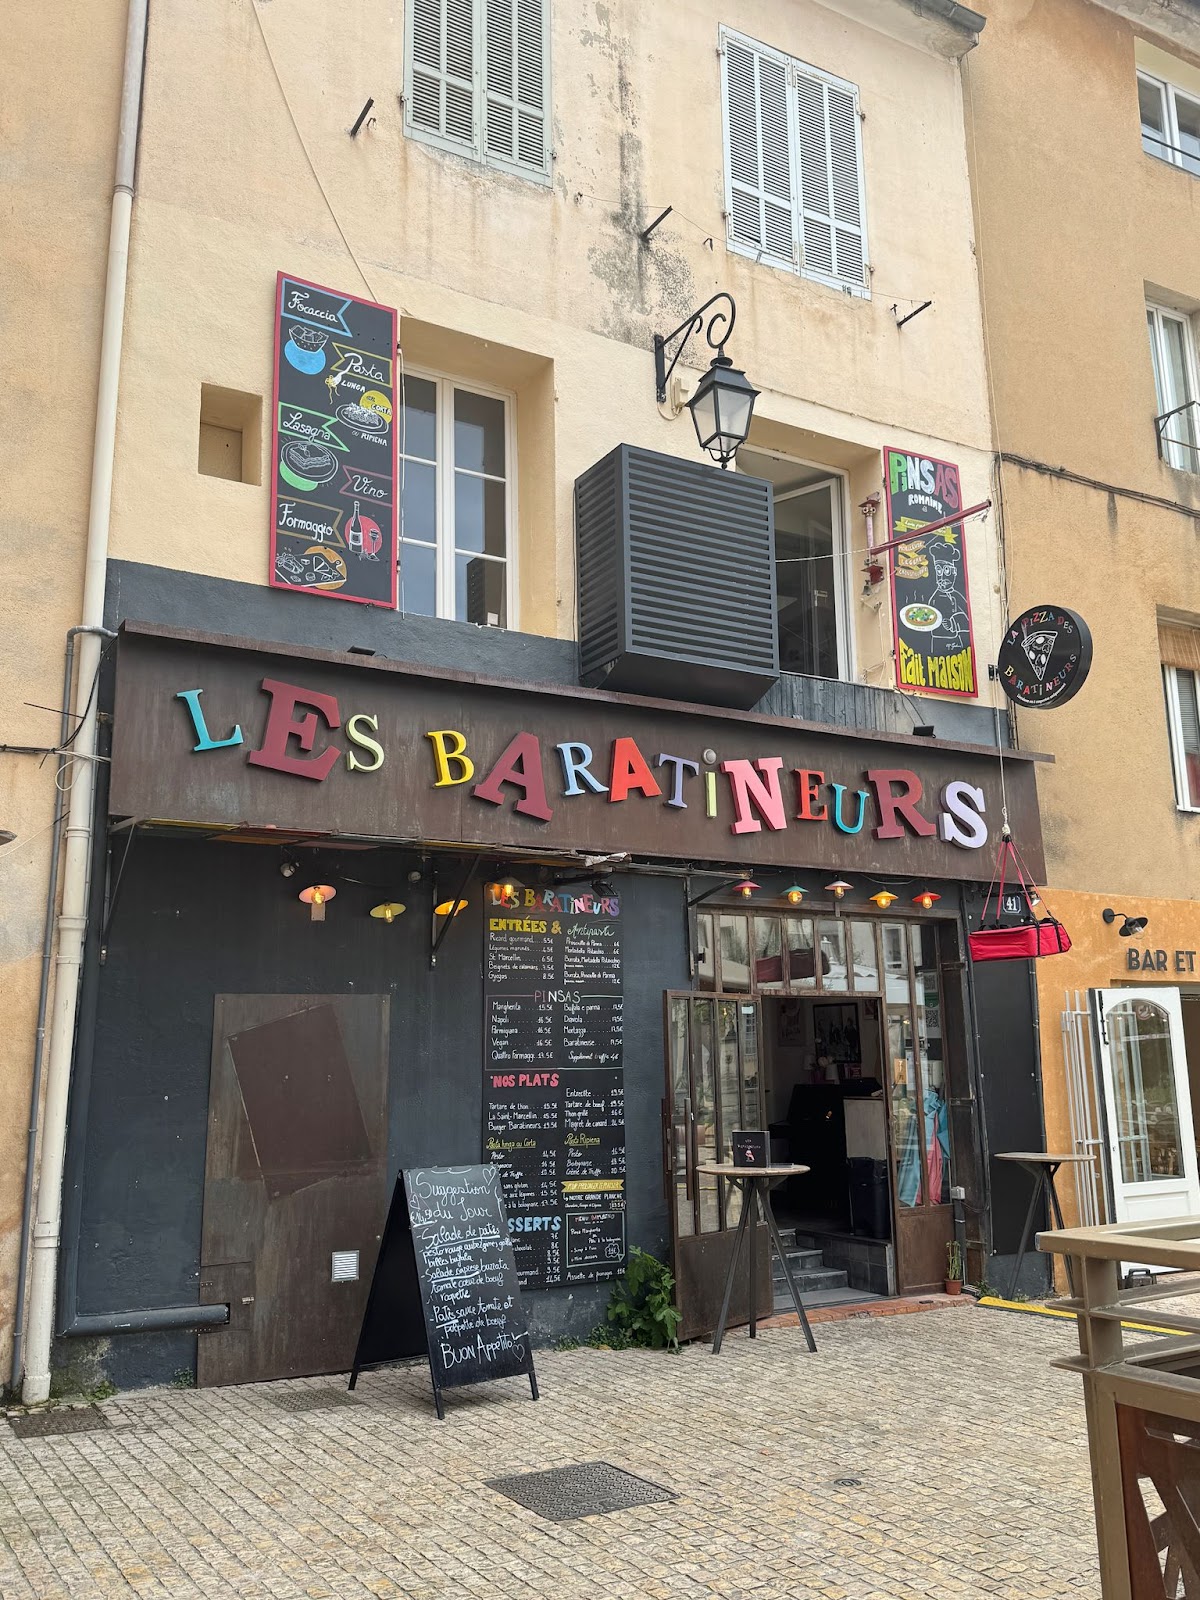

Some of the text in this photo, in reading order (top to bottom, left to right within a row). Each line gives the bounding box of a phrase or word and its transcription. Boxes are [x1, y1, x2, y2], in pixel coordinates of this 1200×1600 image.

[288, 291, 338, 323] Focaccia
[344, 352, 385, 382] Pasta
[341, 381, 366, 393] LUNGA
[283, 413, 331, 442] Lasagna
[352, 474, 389, 498] Vino
[278, 502, 334, 543] Formaggio
[1007, 611, 1074, 645] LA PIZZA DES
[1005, 897, 1018, 911] 41
[489, 915, 547, 934] ENTRÉES
[551, 920, 562, 934] &
[1128, 948, 1197, 972] BAR ET
[534, 990, 581, 1003] PINSAS
[492, 1037, 508, 1050] Vegan
[492, 1073, 560, 1088] NOS PLATS
[489, 1102, 508, 1110] Tartare
[565, 1100, 583, 1108] Tartare
[584, 1100, 592, 1108] de
[488, 1112, 496, 1120] La
[564, 1119, 584, 1132] Magret
[585, 1119, 592, 1127] de
[488, 1121, 506, 1135] Burger
[416, 1172, 490, 1206] Suggestion
[433, 1201, 453, 1220] du
[457, 1197, 492, 1221] Jour
[507, 1216, 562, 1233] SSERTS
[421, 1225, 464, 1249] Salade
[466, 1225, 477, 1238] de
[425, 1267, 454, 1282] Salade
[480, 1258, 509, 1273] burrata
[456, 1305, 477, 1318] sauce
[477, 1296, 502, 1315] tomate
[503, 1295, 514, 1309] et
